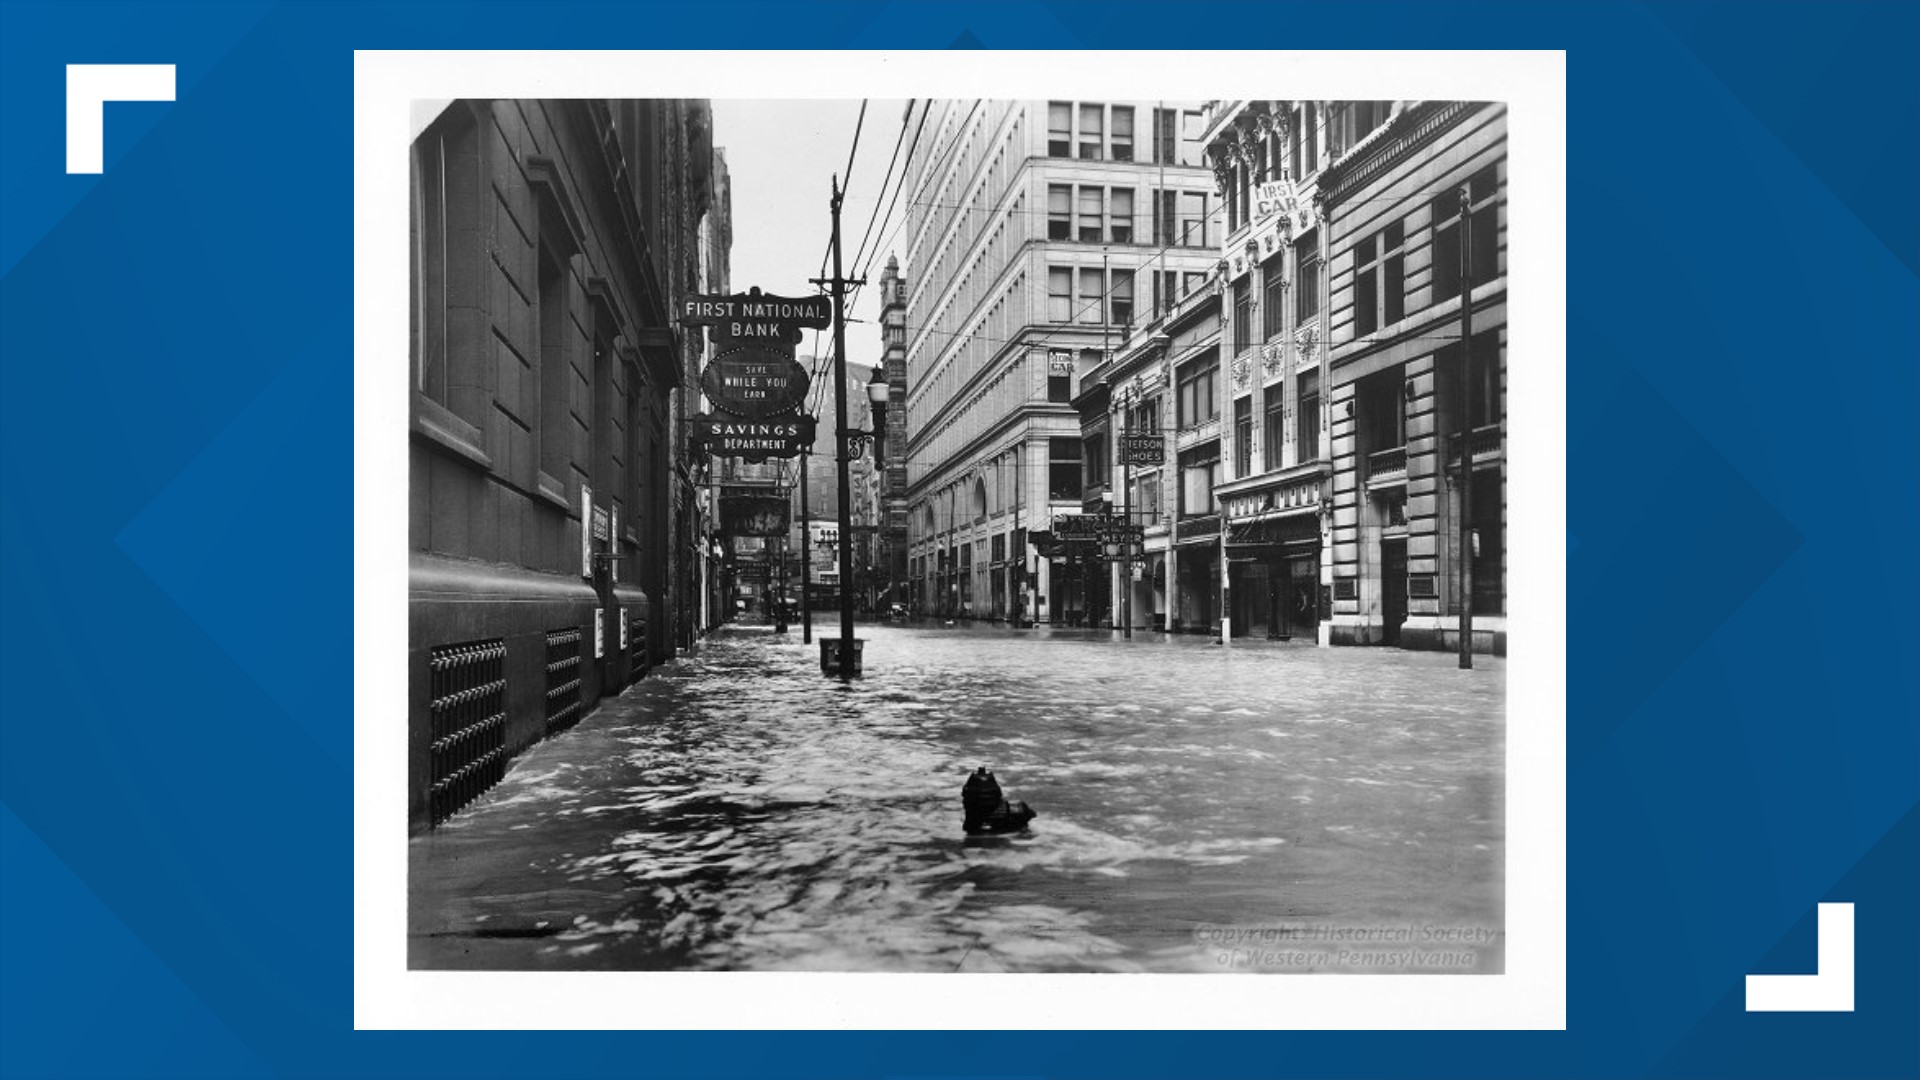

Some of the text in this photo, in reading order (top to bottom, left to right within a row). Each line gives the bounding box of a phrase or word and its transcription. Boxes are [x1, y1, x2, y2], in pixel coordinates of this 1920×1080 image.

[1258, 197, 1299, 215] CAR
[685, 302, 826, 319] FIRST NATIONAL
[731, 322, 780, 337] BANK
[745, 366, 768, 375] SAVE
[724, 377, 788, 388] WHILE YOU
[744, 390, 766, 399] EARN
[711, 424, 798, 437] SAVINGS
[724, 439, 787, 450] DEPARTMENT
[1124, 439, 1163, 450] TETSON
